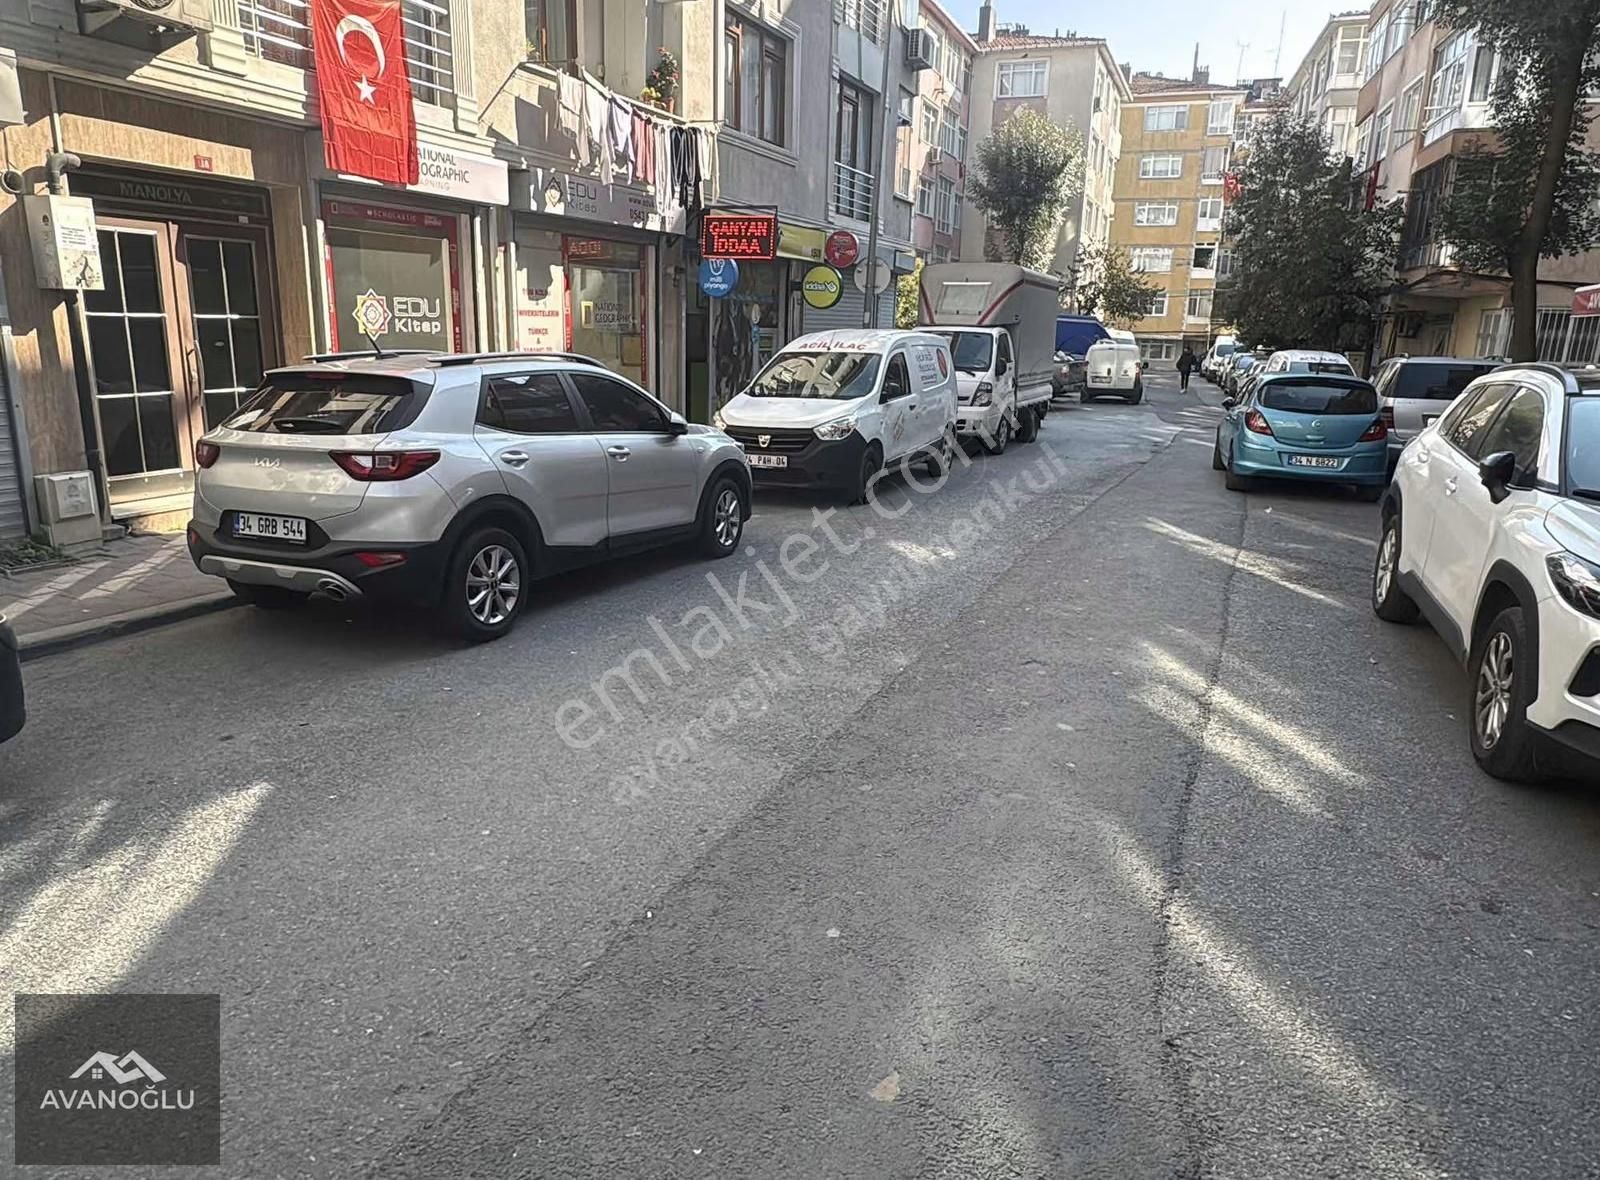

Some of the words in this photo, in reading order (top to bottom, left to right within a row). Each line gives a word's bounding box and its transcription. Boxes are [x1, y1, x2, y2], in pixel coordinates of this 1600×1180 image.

[416, 147, 457, 166] ATIONAL
[420, 162, 470, 184] OGRAPHIC
[119, 181, 193, 204] MANOLYA
[567, 181, 597, 201] EDU
[709, 221, 768, 236] GANYAN
[704, 282, 728, 290] piyango
[393, 297, 441, 317] EDU
[394, 318, 441, 335] Kitap
[758, 455, 772, 465] PAH
[1292, 457, 1303, 465] 34
[1306, 458, 1313, 466] N
[240, 515, 252, 533] 34
[257, 517, 278, 535] GRB
[283, 519, 304, 538] 544
